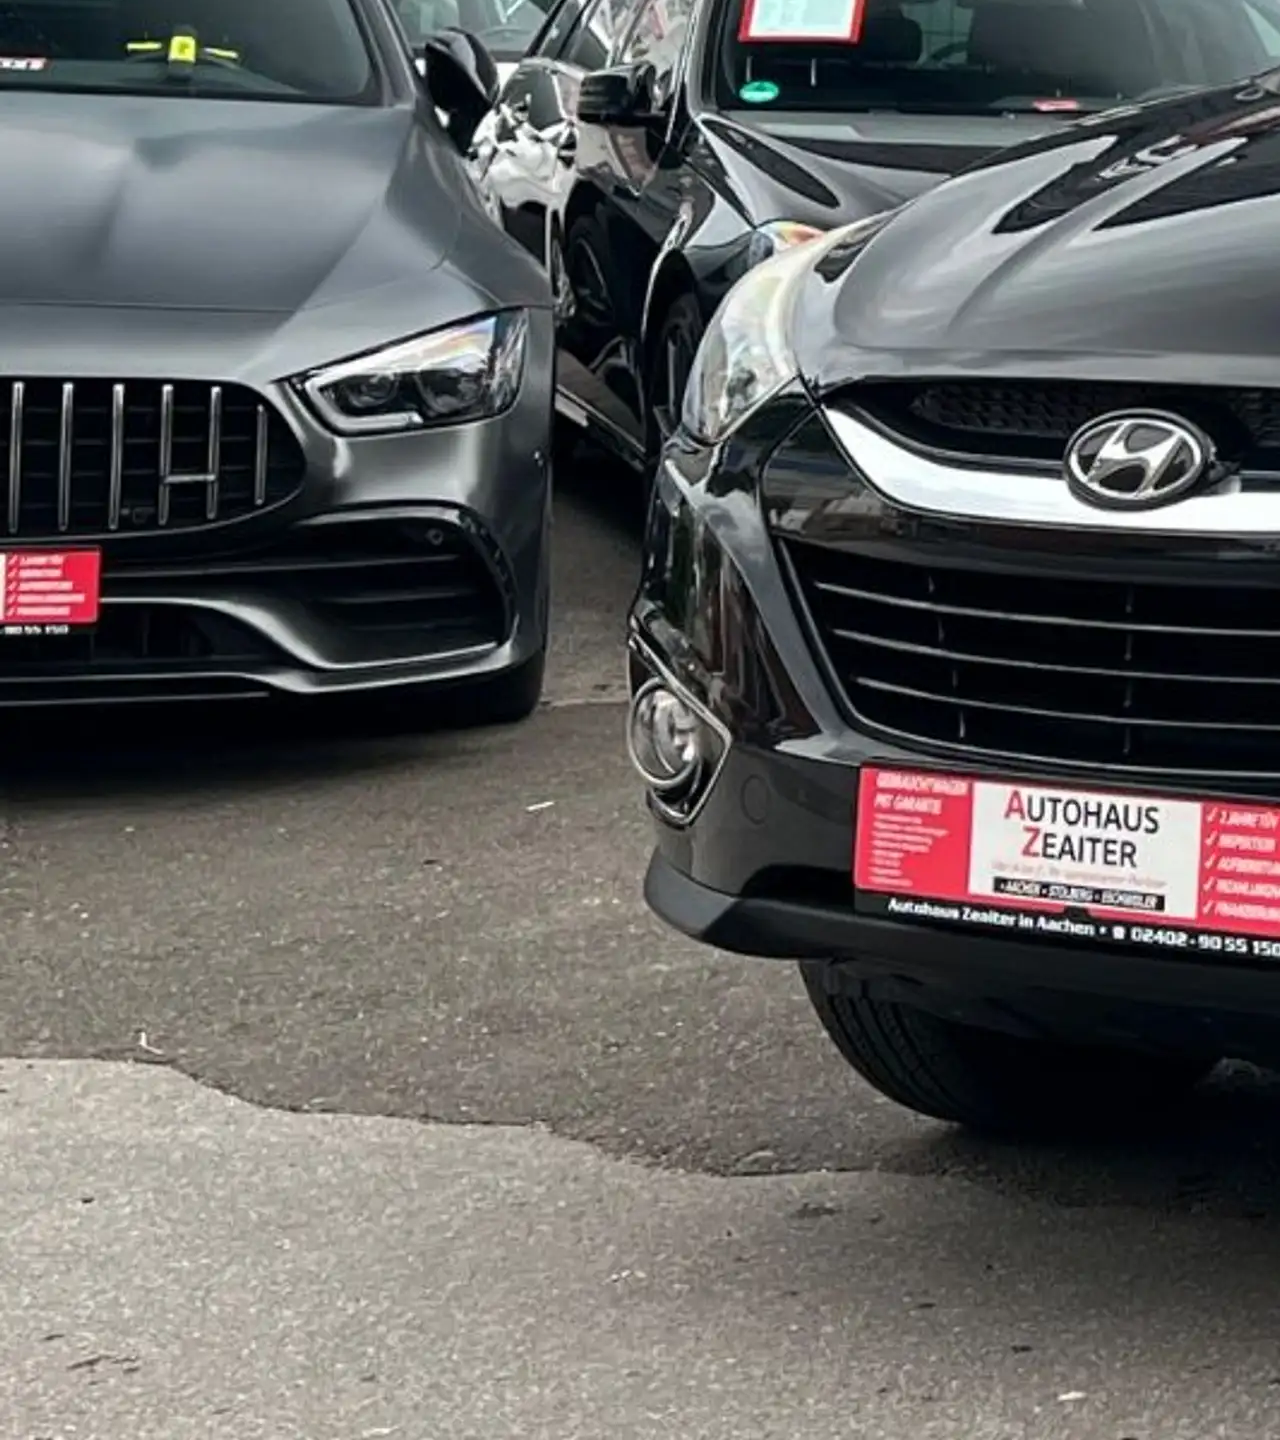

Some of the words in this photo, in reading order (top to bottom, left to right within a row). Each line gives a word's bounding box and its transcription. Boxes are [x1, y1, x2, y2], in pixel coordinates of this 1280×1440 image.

[1003, 789, 1160, 834] AUTOHAUS
[1021, 825, 1138, 868] ZEAITER
[888, 897, 960, 921] Autohaus
[962, 907, 1017, 928] Zeaiter
[1018, 914, 1034, 929] in
[1036, 915, 1096, 937] Aachen
